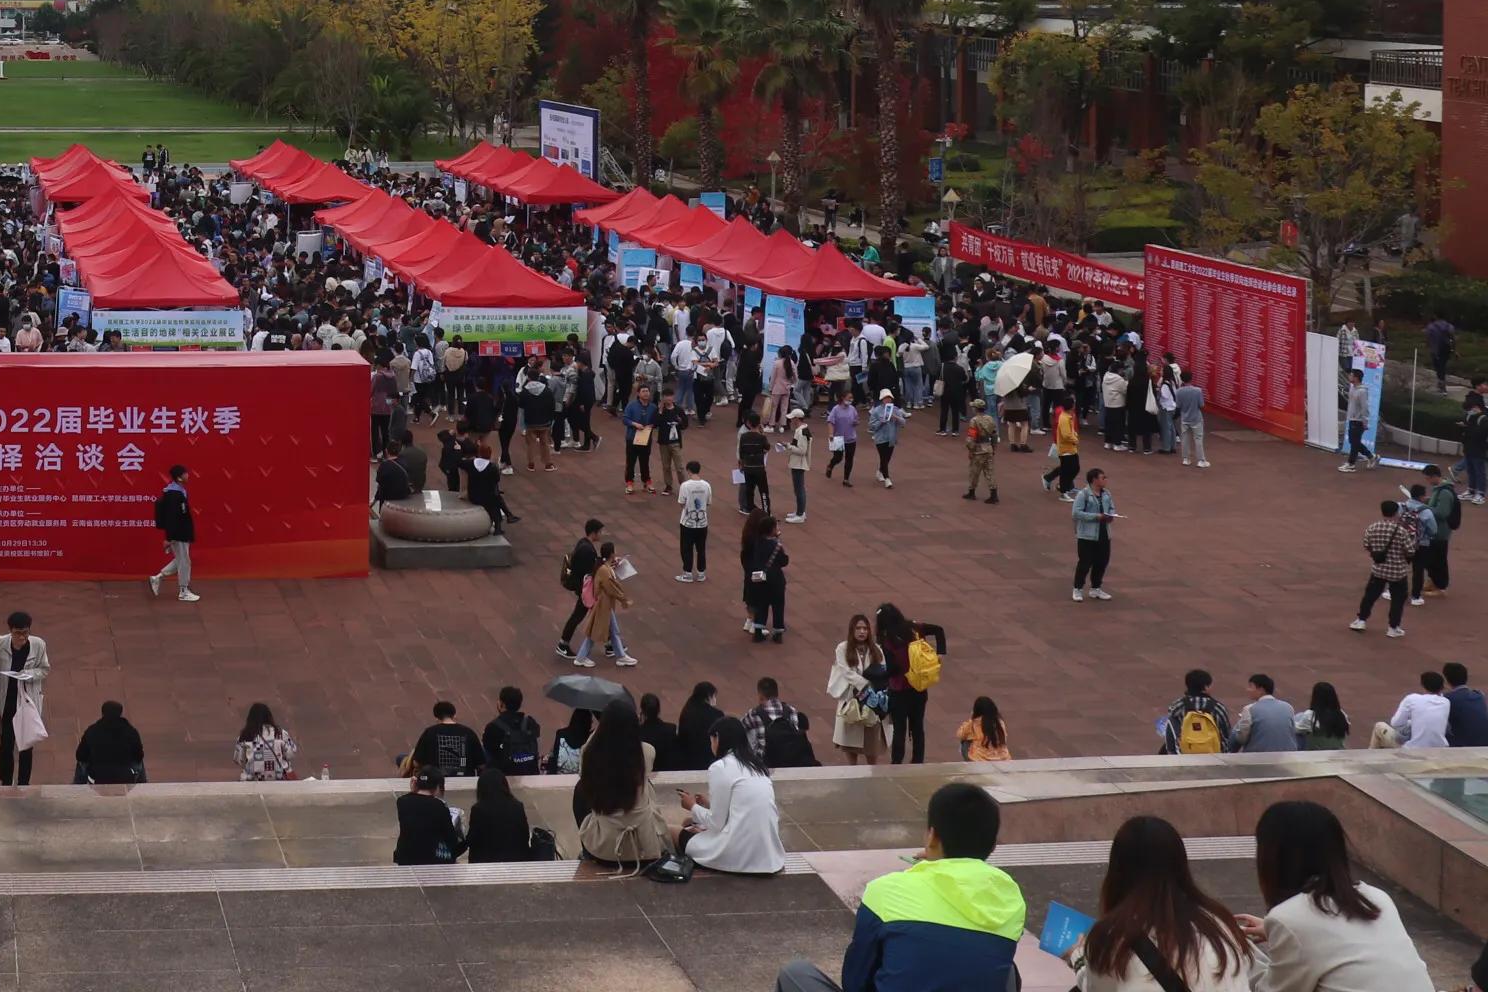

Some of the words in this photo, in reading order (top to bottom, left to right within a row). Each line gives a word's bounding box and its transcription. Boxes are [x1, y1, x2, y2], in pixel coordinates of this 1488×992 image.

[71, 495, 158, 503] 昆明理工大学就业指导中心
